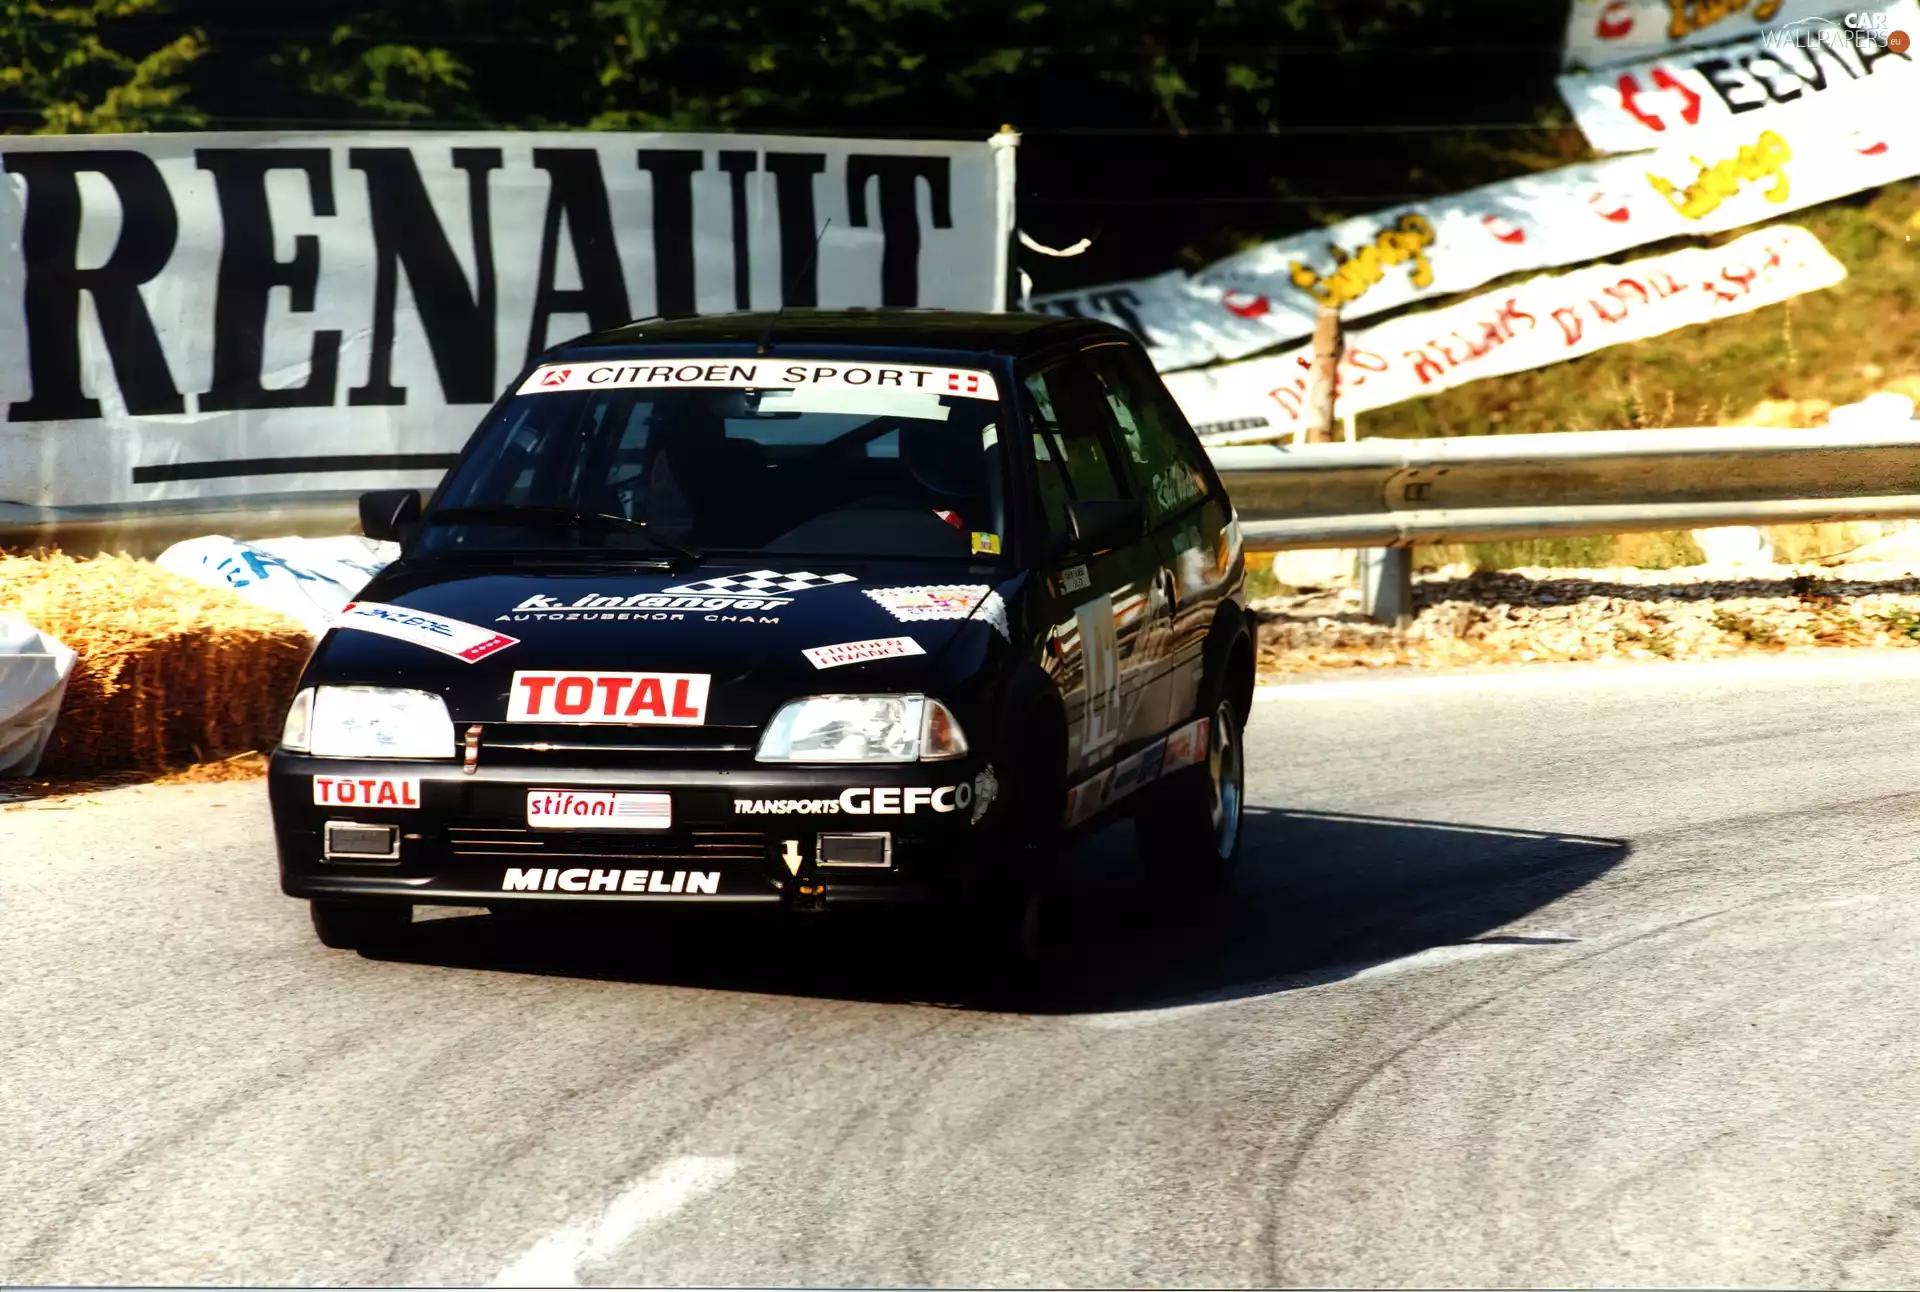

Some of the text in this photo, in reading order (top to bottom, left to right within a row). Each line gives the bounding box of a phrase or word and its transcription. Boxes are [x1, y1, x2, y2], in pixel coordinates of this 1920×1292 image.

[3, 147, 953, 422] RENAULT
[782, 366, 934, 390] SPORT
[704, 613, 781, 625] CHAM
[519, 677, 699, 718] TOTAL
[316, 779, 418, 806] TOTAL
[531, 792, 616, 817] stifani
[734, 782, 972, 814] TRANSPORTS GEFCO
[502, 868, 721, 894] MICHELIN
